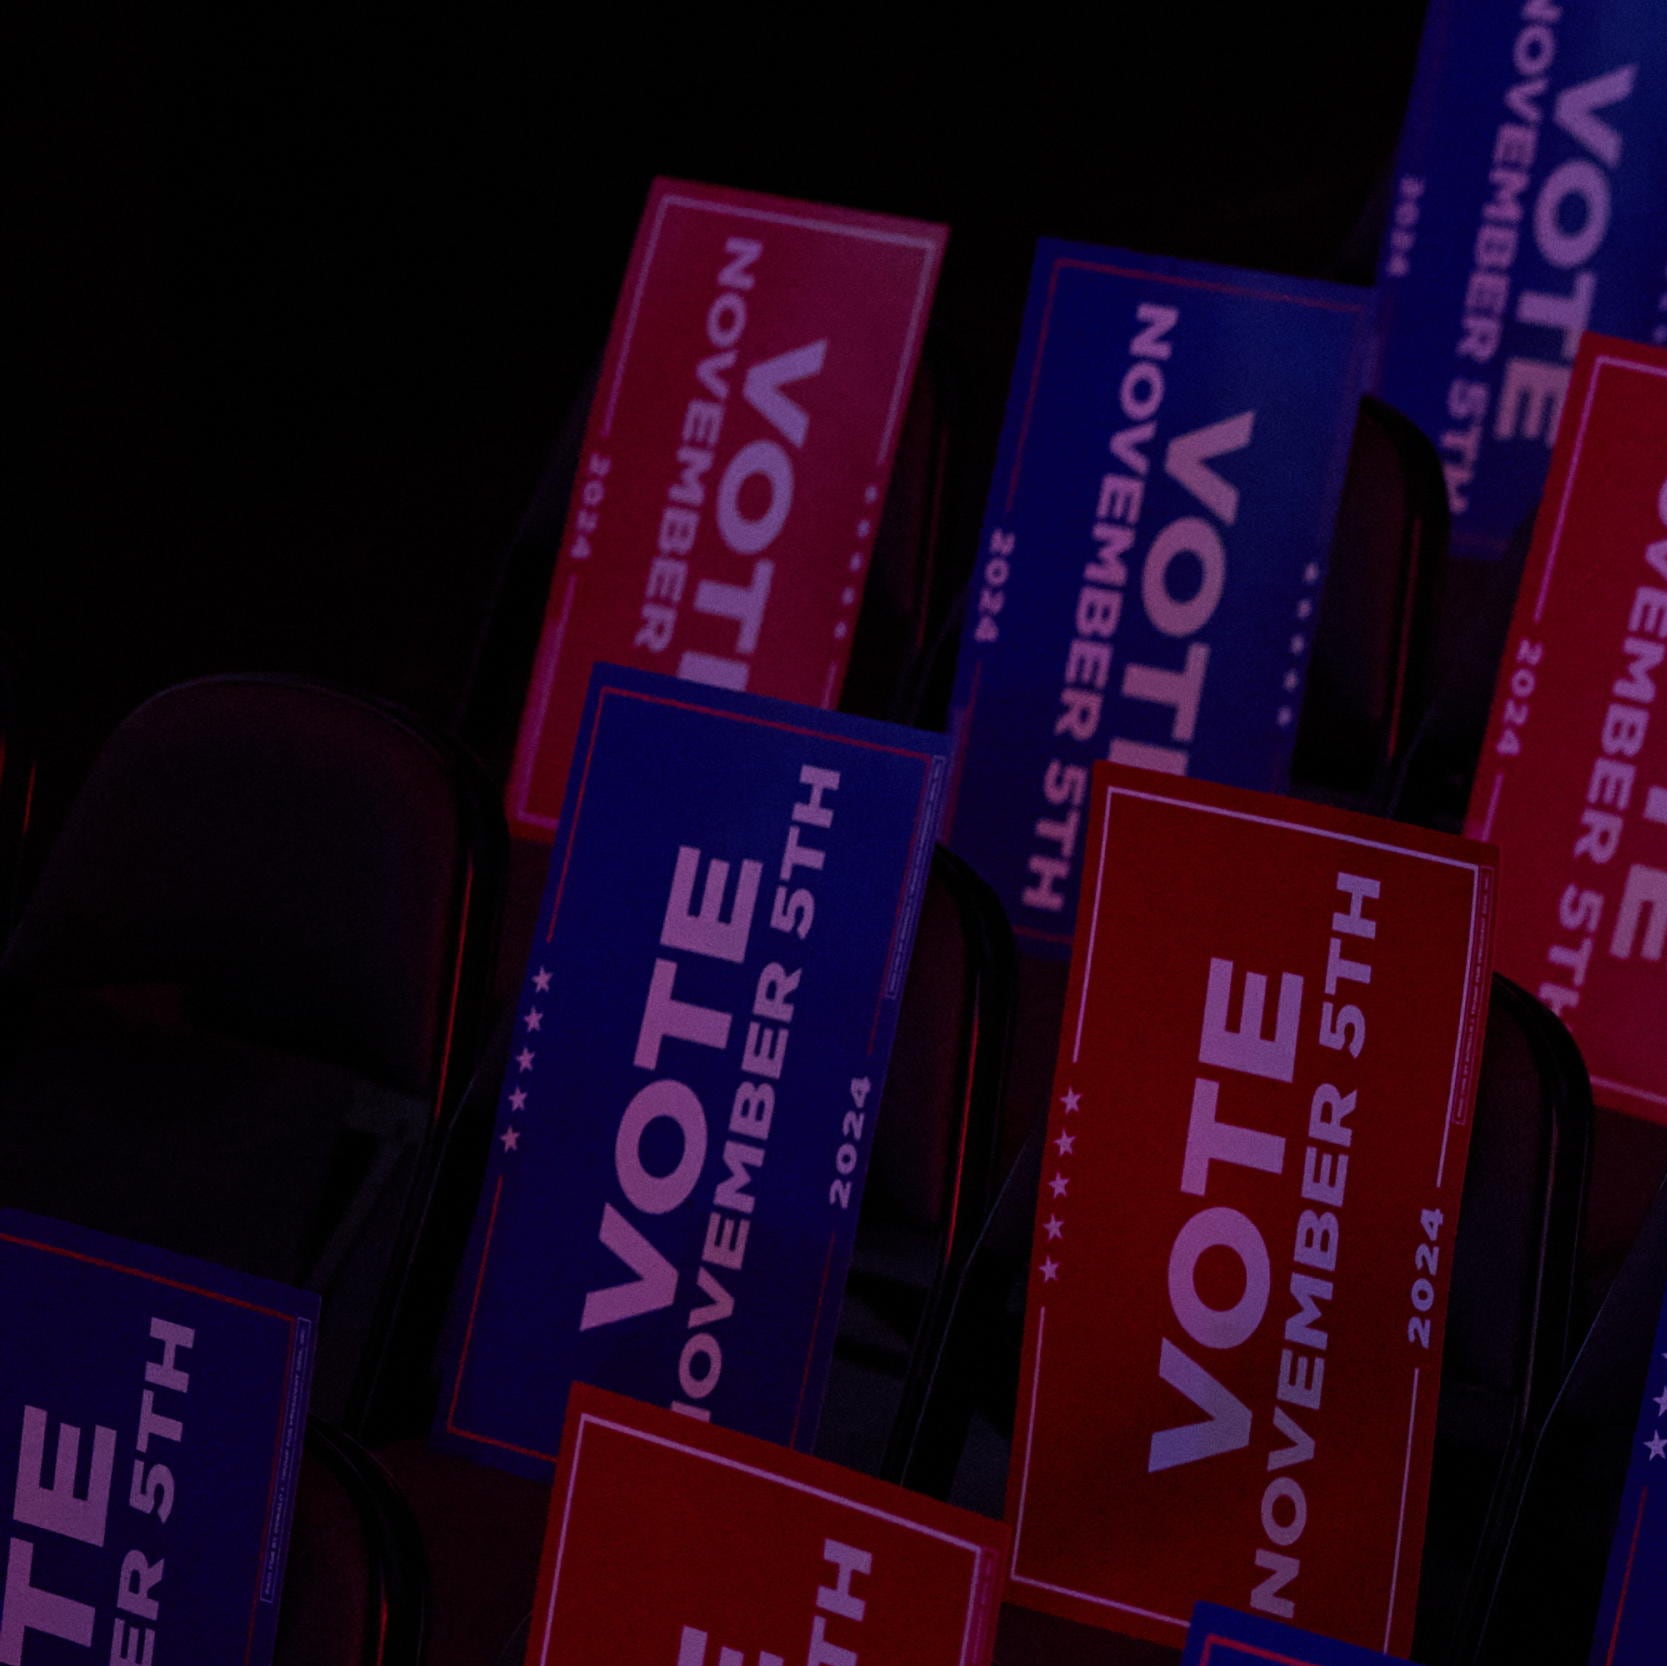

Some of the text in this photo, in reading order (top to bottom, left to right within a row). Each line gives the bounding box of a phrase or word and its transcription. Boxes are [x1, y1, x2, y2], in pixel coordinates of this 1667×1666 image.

[635, 238, 762, 652] NOVEMBER
[1495, 64, 1637, 447] VOTE
[571, 454, 610, 558] 2024
[974, 529, 1015, 641] 2024
[1022, 303, 1179, 910] NOVEMBER 5TH
[1497, 640, 1542, 754] 2024
[579, 845, 763, 1332] VOTE
[670, 764, 841, 1422] OVEMBER 5TH
[829, 1077, 871, 1209] 2024
[1147, 957, 1304, 1473] VOTE
[1249, 871, 1381, 1619] NOVEMBER 5TH
[1407, 1208, 1444, 1349] 2024
[129, 1316, 196, 1523] 5TH
